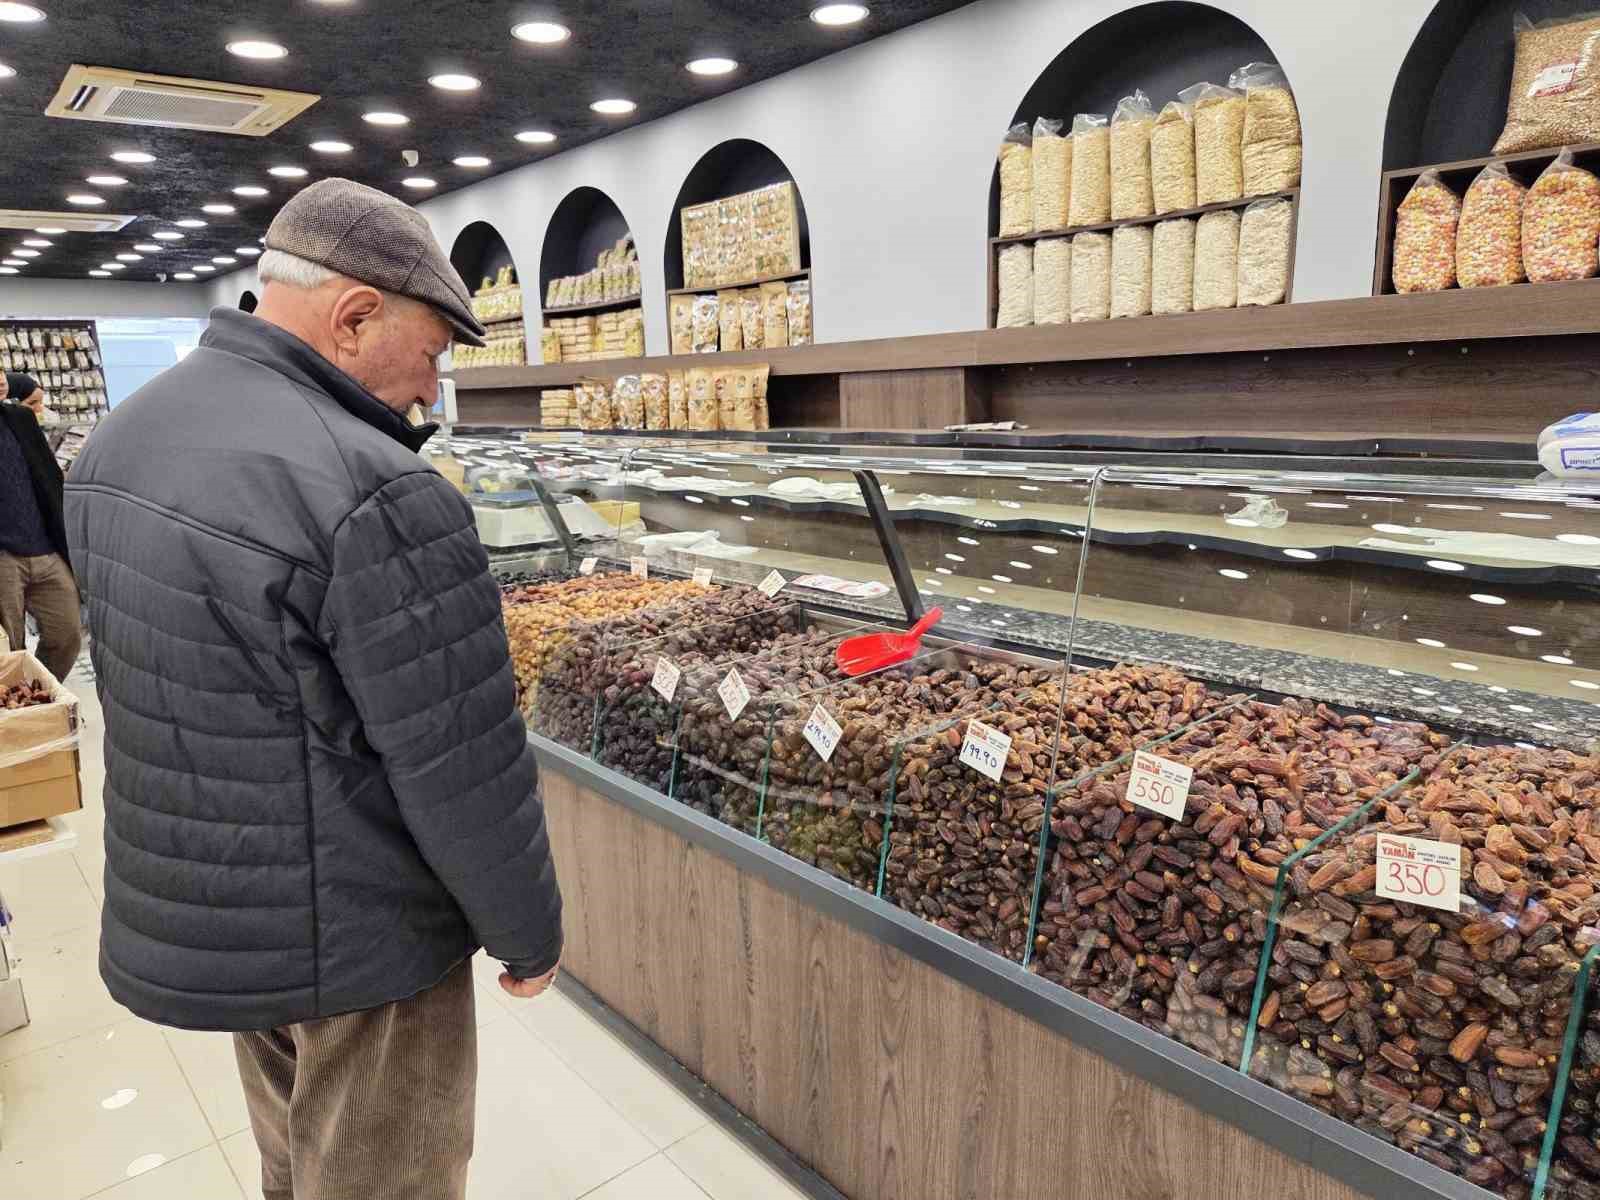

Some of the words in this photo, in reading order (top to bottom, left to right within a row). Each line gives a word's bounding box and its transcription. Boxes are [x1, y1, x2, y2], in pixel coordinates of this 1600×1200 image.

[963, 740, 997, 768] 199.90
[1135, 776, 1174, 805] 550
[1382, 847, 1416, 860] YAMAN
[1385, 862, 1446, 896] 350
